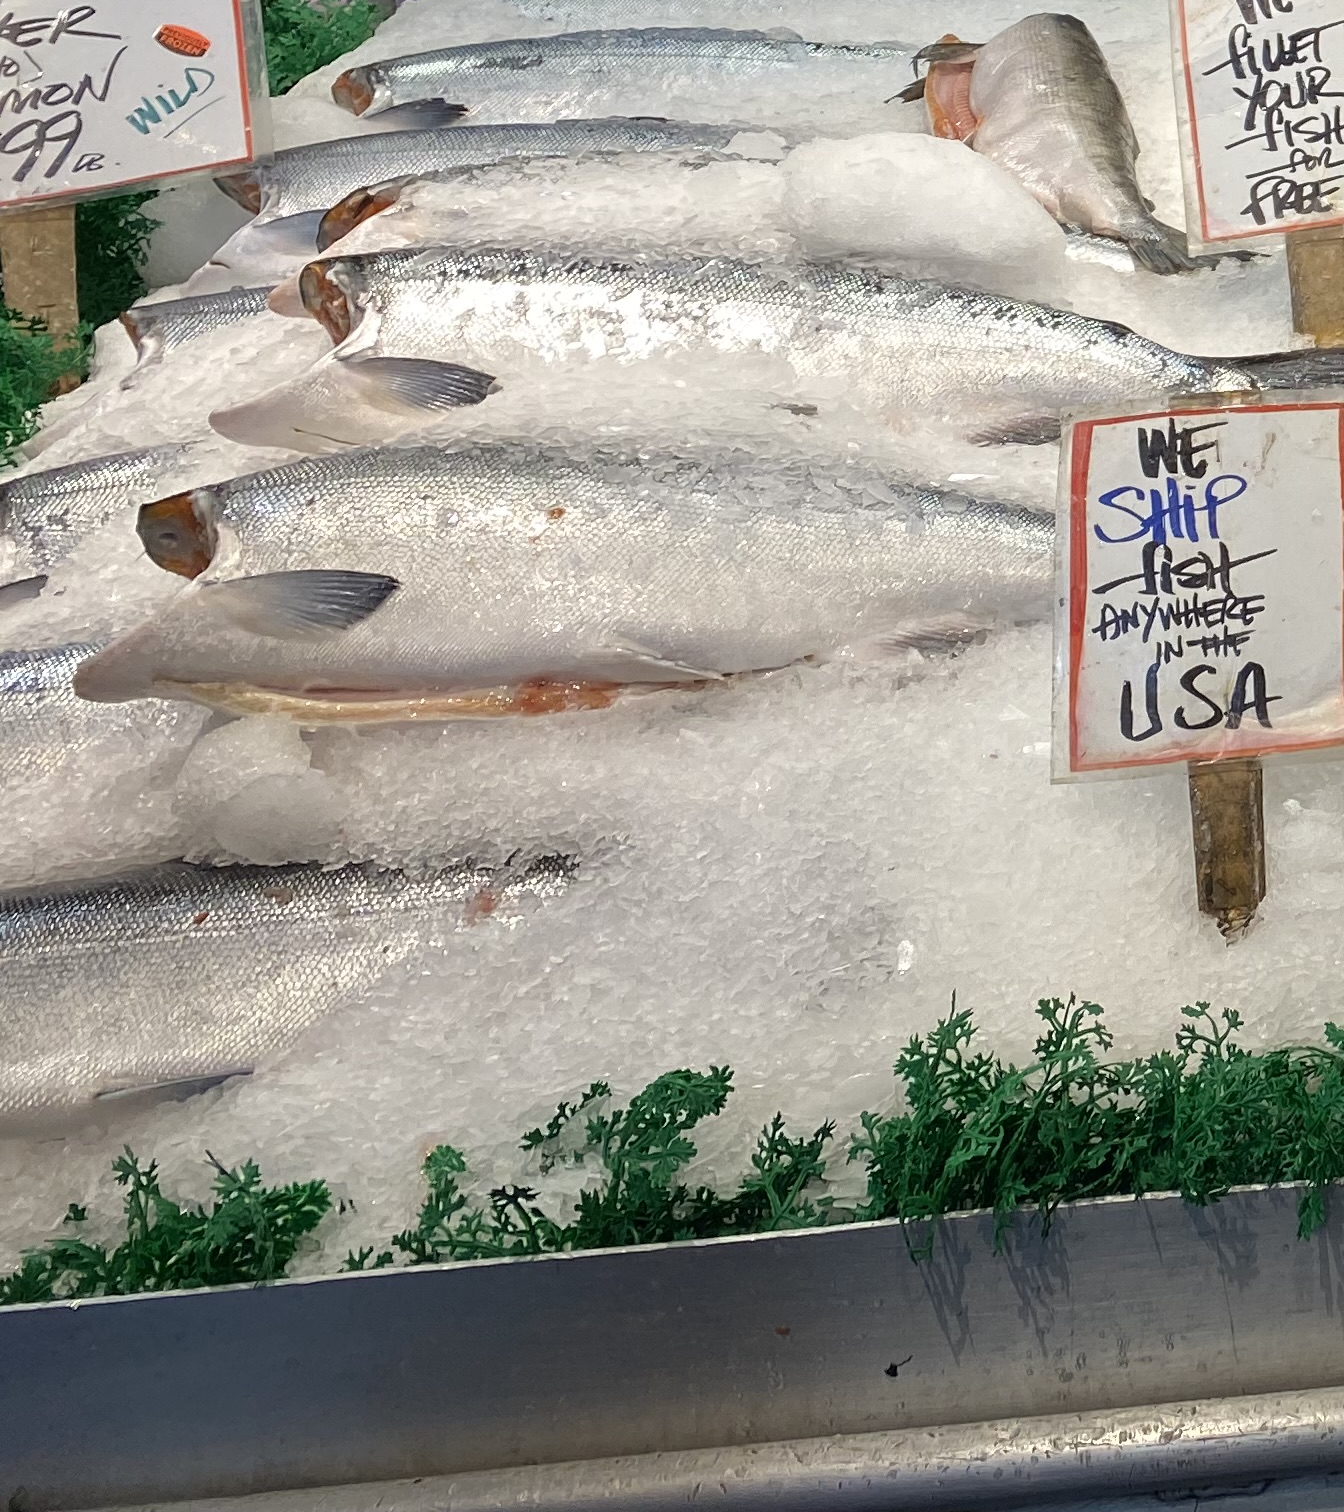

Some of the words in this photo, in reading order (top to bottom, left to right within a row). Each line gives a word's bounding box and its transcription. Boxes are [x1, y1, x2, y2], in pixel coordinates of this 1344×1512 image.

[125, 68, 215, 135] WILD
[1138, 418, 1228, 479] WE
[1094, 474, 1247, 544] SHIP
[1092, 593, 1265, 641] ANYWHERE
[1156, 636, 1183, 663] IN
[1120, 661, 1283, 741] USA
